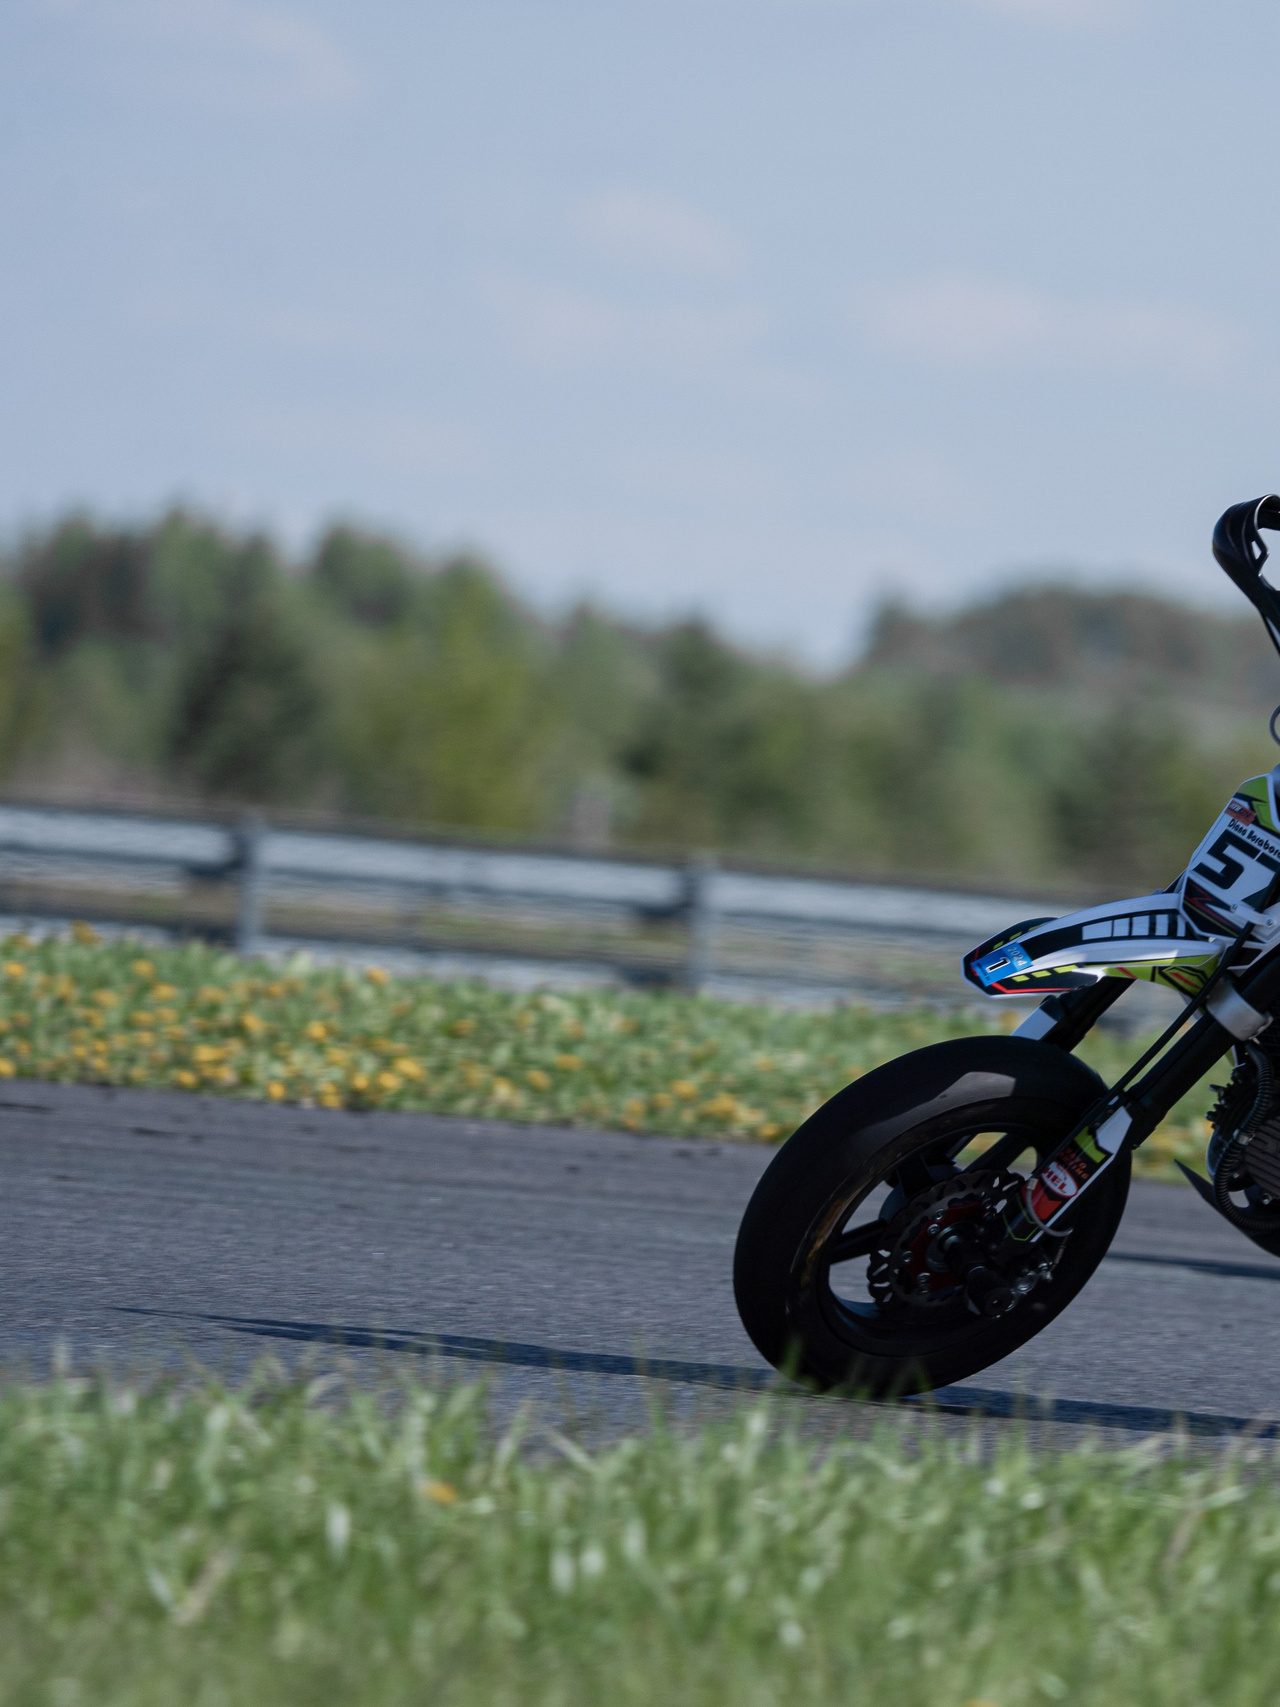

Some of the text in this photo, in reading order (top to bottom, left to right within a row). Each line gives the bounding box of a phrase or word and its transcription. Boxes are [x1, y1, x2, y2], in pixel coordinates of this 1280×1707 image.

[1227, 818, 1247, 836] Diana
[985, 956, 1011, 973] 1
[1007, 946, 1028, 967] 2024
